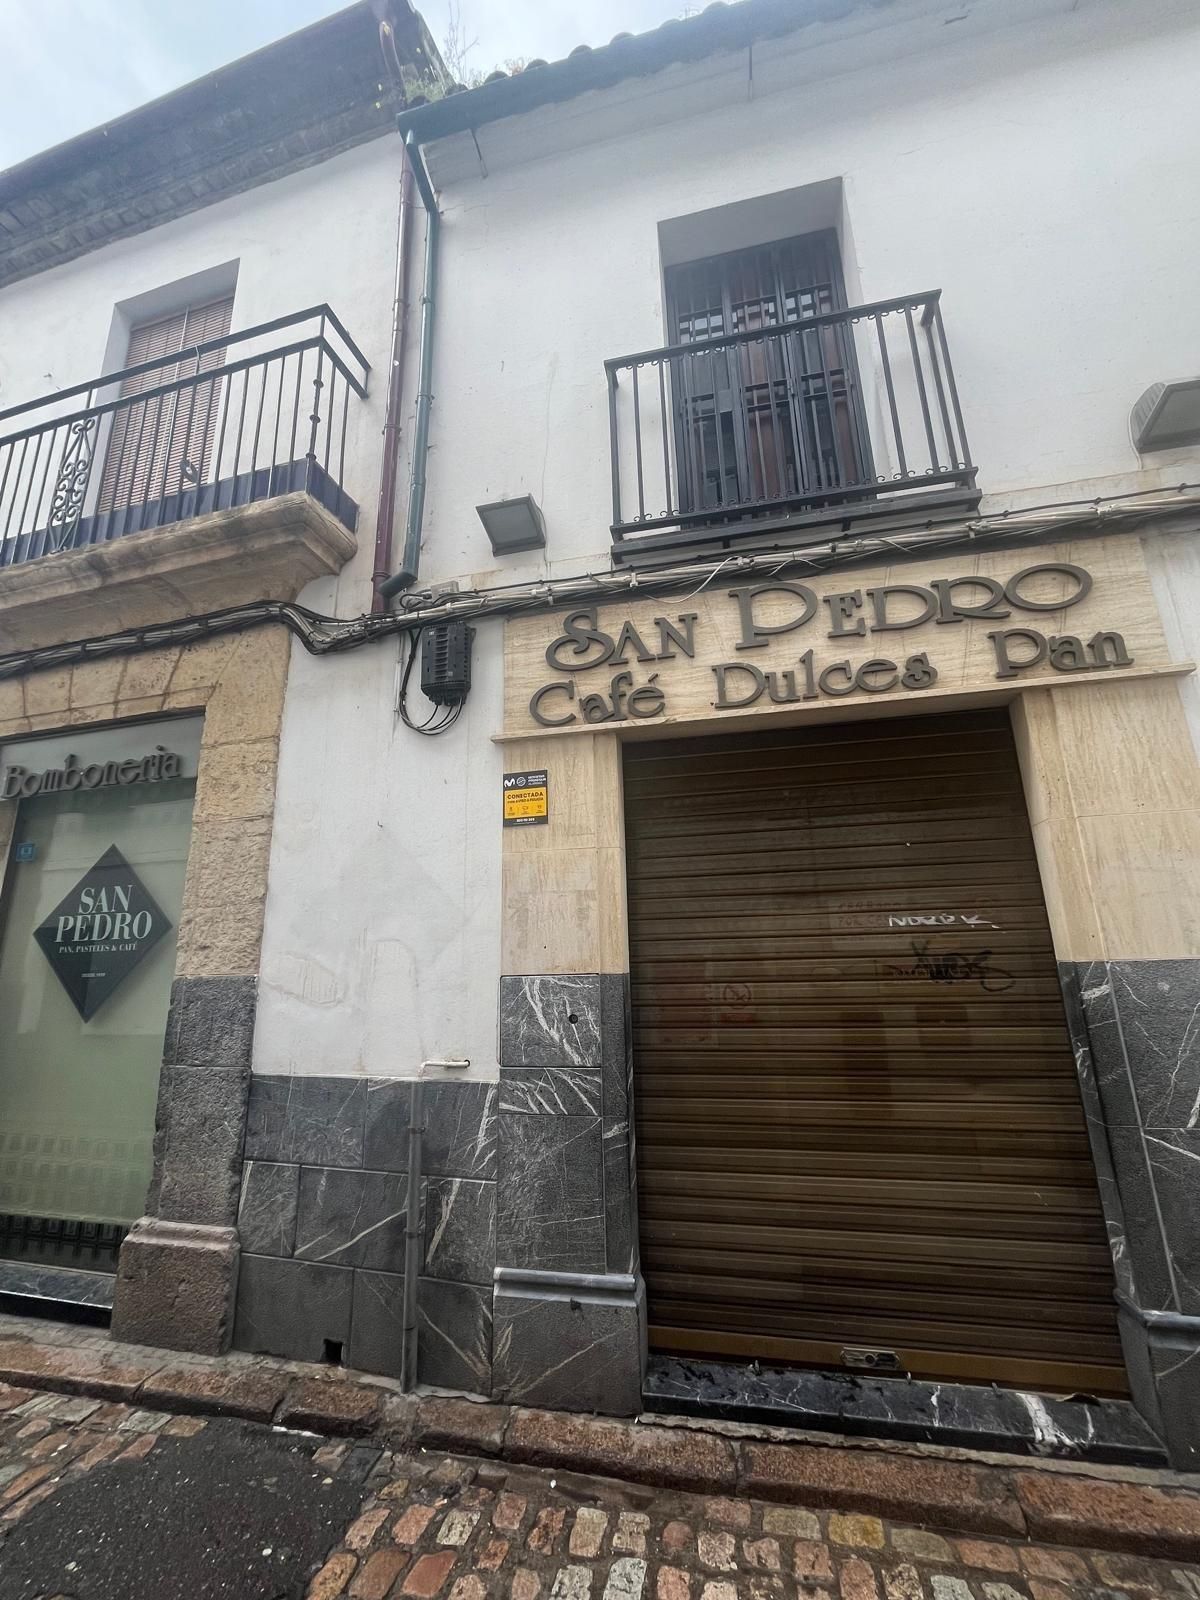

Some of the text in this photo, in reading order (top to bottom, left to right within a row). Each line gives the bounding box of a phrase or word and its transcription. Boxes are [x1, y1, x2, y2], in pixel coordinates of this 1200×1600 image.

[545, 563, 1093, 671] SAN PEDRO
[529, 671, 666, 726] Café
[711, 649, 938, 709] Dulces
[54, 884, 153, 943] SAN PEDRO
[76, 944, 110, 953] PASTELES
